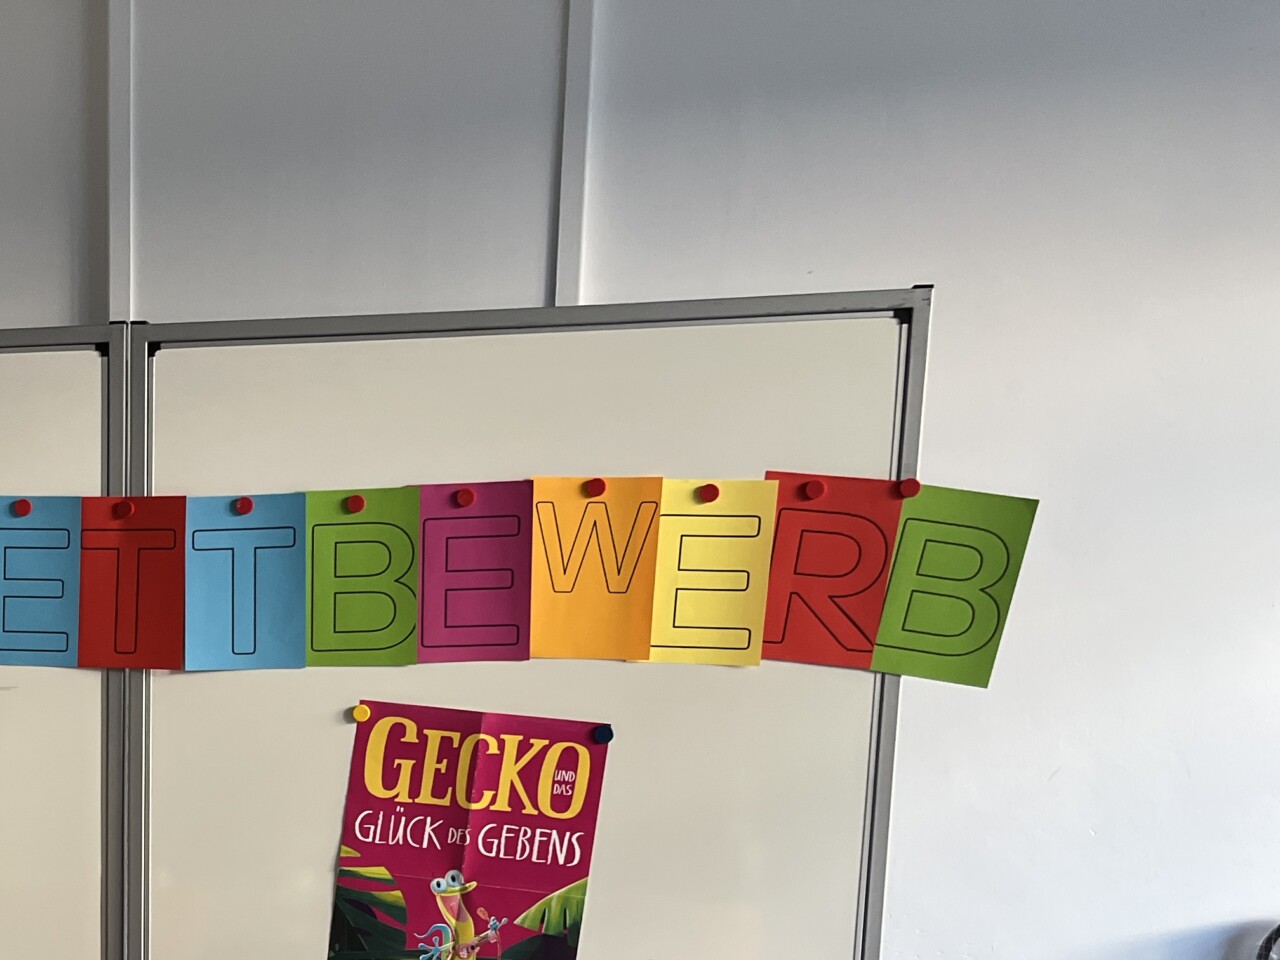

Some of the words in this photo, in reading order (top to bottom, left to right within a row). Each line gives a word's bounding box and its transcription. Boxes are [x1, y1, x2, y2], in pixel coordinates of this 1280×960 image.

[364, 716, 591, 820] GECKO
[554, 769, 576, 783] UND
[552, 783, 573, 796] DAS
[354, 806, 444, 851] GLÜCK
[447, 828, 472, 846] DES
[477, 823, 585, 867] GEBENS
